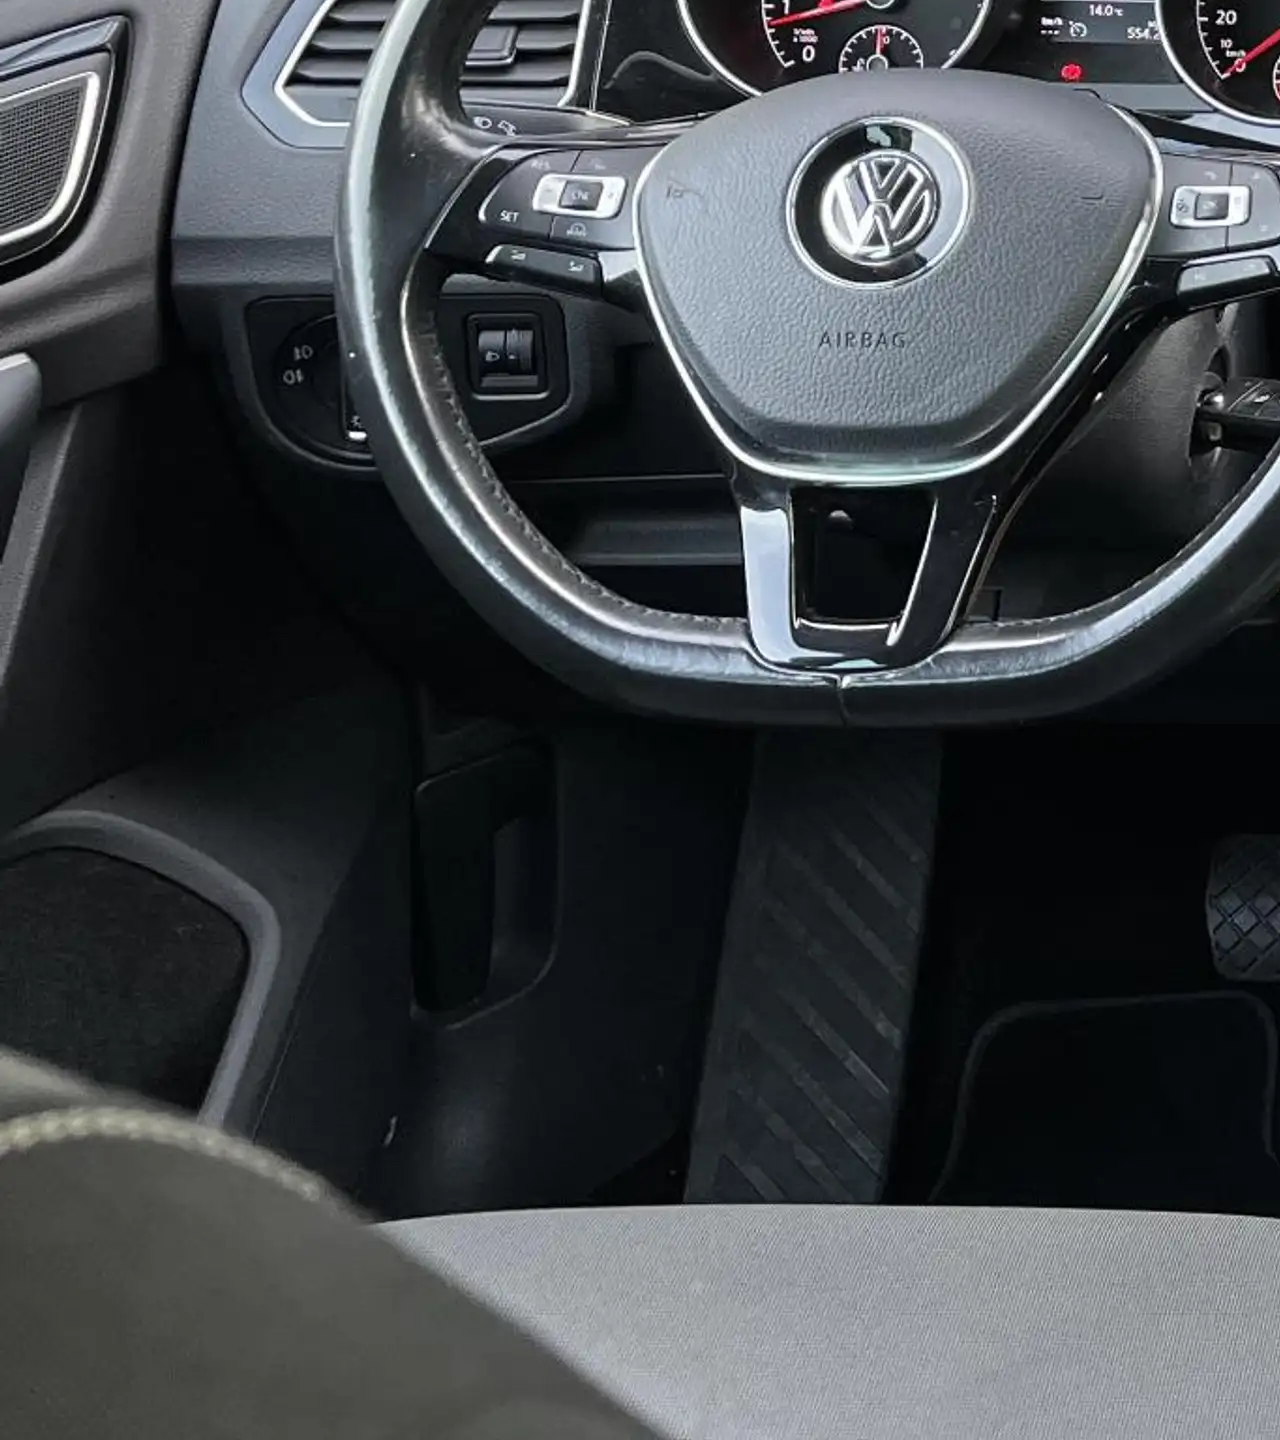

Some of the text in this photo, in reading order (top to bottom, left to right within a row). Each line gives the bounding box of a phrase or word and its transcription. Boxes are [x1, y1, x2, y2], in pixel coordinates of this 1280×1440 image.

[1215, 10, 1237, 25] 20
[1220, 39, 1233, 49] 10
[802, 44, 815, 62] 0
[500, 210, 520, 223] SET
[818, 331, 906, 350] AIRBAG
